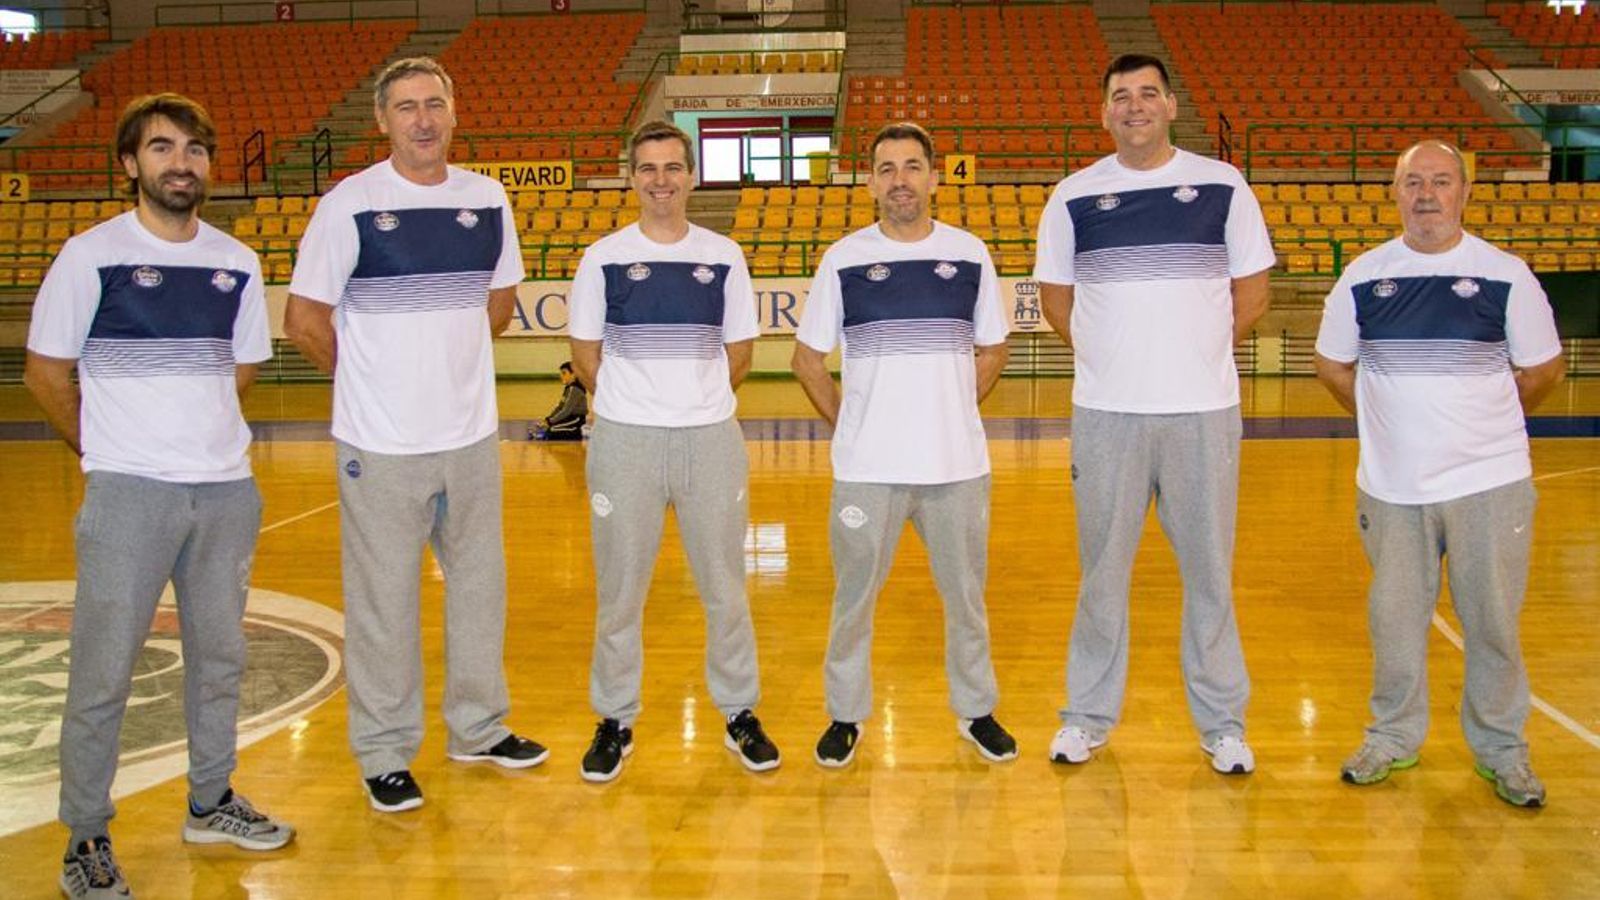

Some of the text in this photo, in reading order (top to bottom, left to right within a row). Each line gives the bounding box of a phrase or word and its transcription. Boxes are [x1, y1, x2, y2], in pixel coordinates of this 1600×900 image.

[281, 4, 291, 20] 2
[725, 98, 742, 108] DE
[760, 96, 836, 108] EMERXENCIA
[471, 165, 567, 187] EVARD
[953, 160, 968, 180] 4
[9, 179, 22, 197] 2
